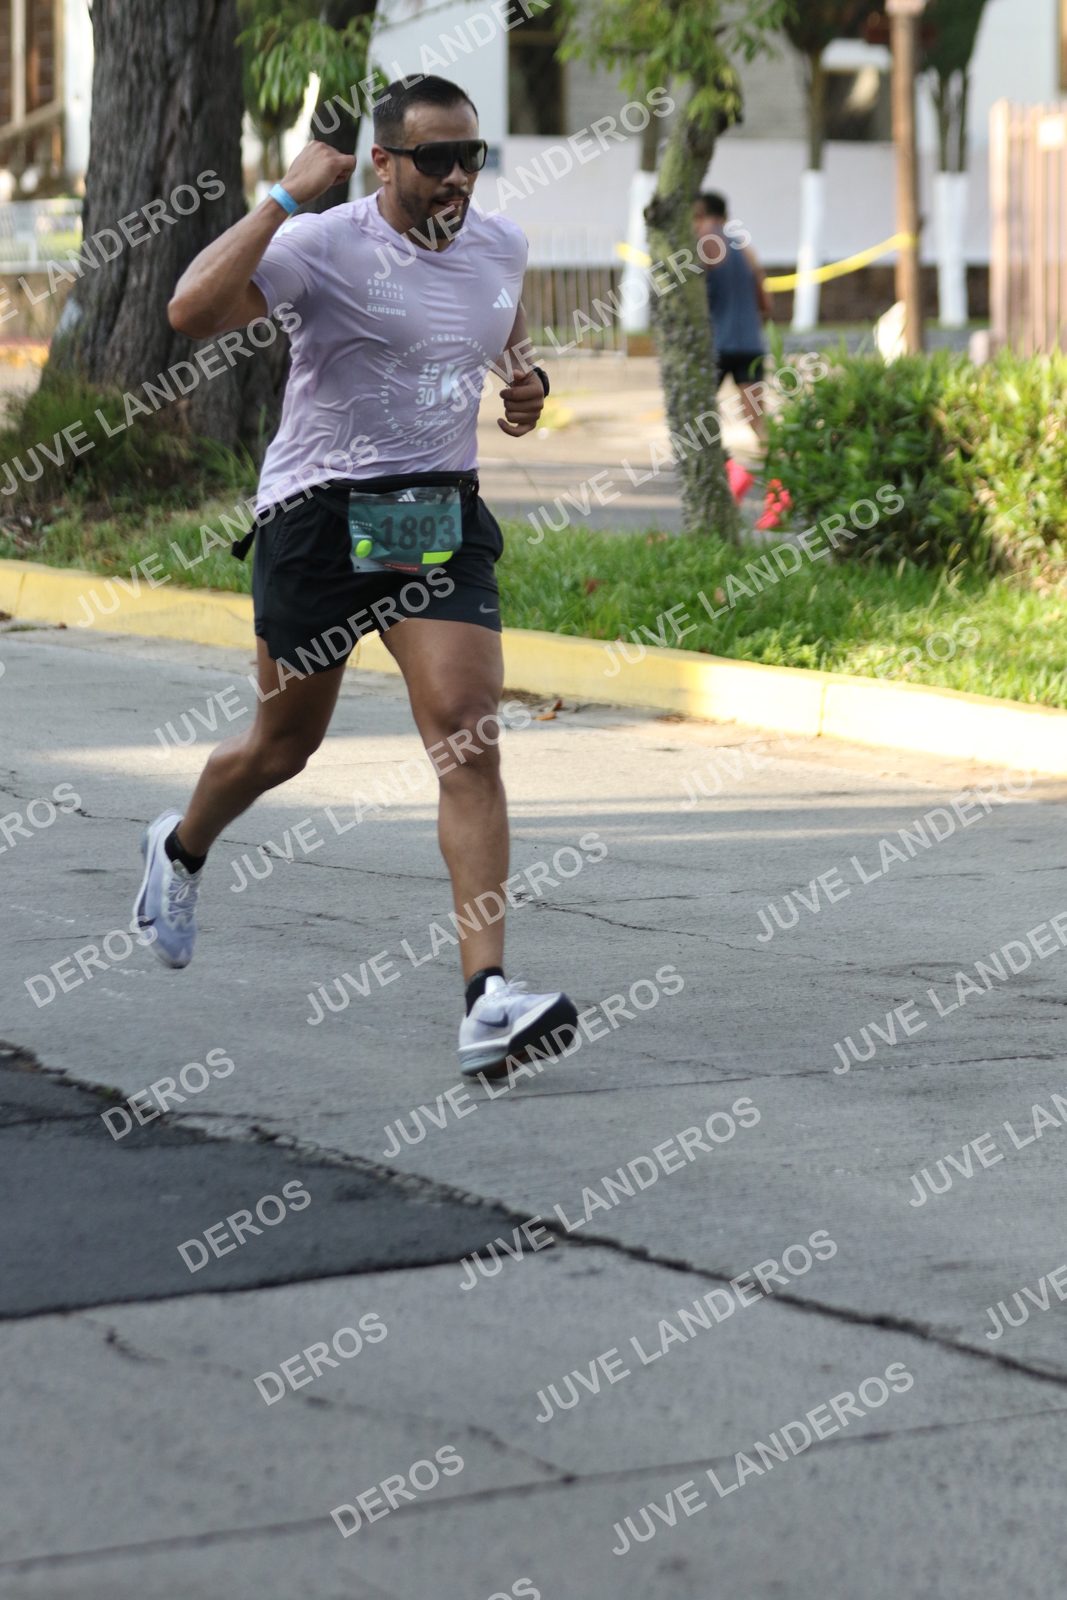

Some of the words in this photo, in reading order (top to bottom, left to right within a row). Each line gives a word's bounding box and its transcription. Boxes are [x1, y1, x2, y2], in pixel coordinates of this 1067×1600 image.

[367, 304, 407, 317] SAMSUNG
[415, 387, 435, 407] 30
[380, 514, 457, 550] 1893
